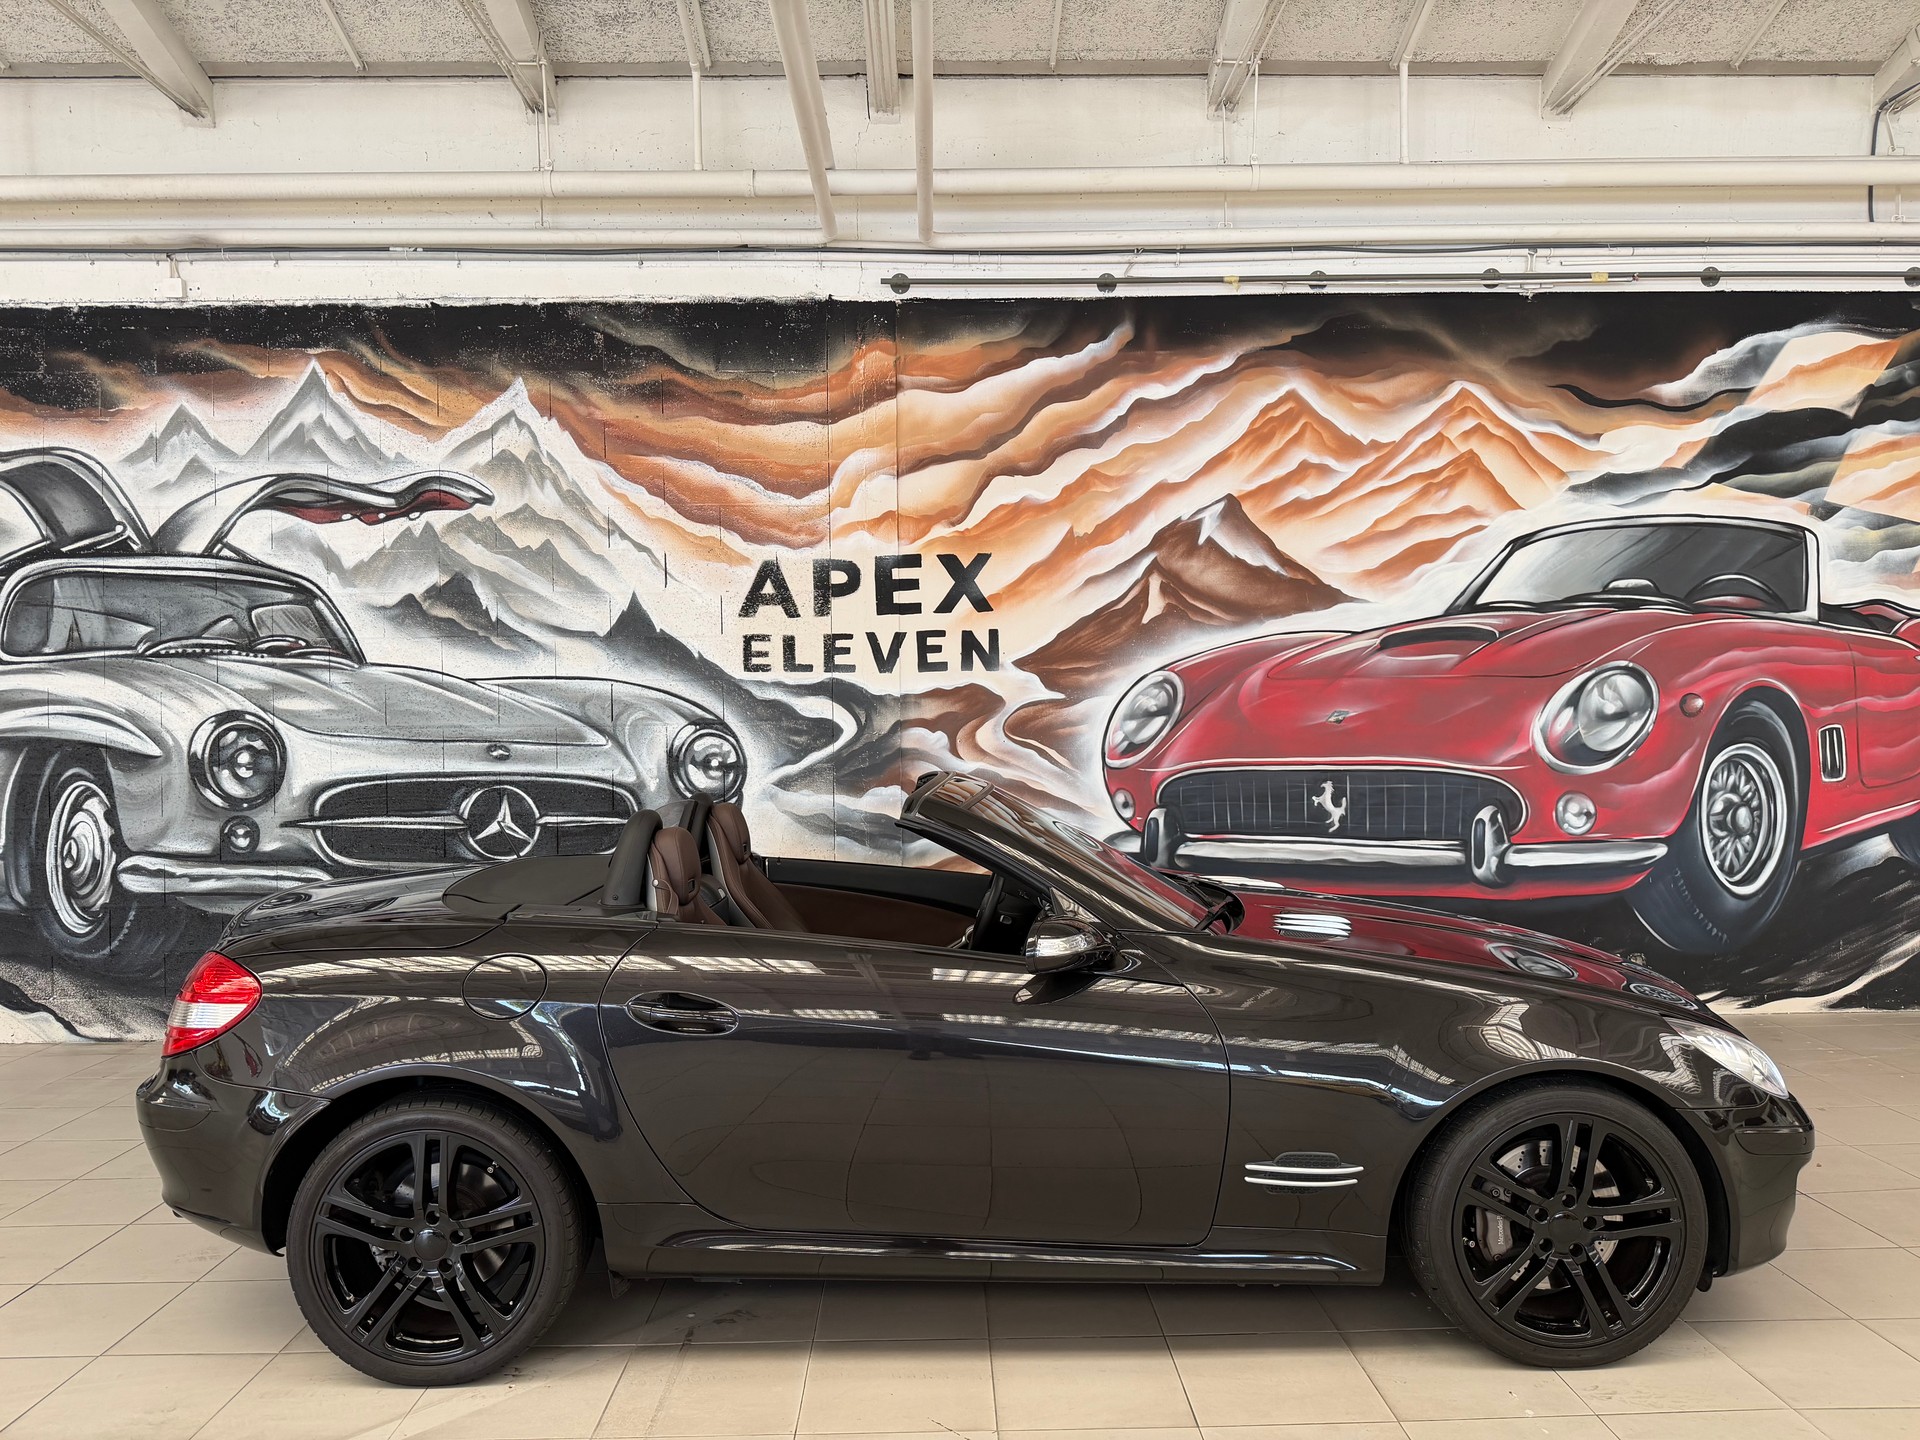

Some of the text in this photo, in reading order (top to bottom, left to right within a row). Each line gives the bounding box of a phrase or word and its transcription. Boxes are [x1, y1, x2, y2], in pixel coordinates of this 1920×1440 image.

[738, 552, 994, 619] APEX
[742, 628, 1001, 674] ELEVEN
[1496, 1215, 1504, 1245] Mercedes-B
